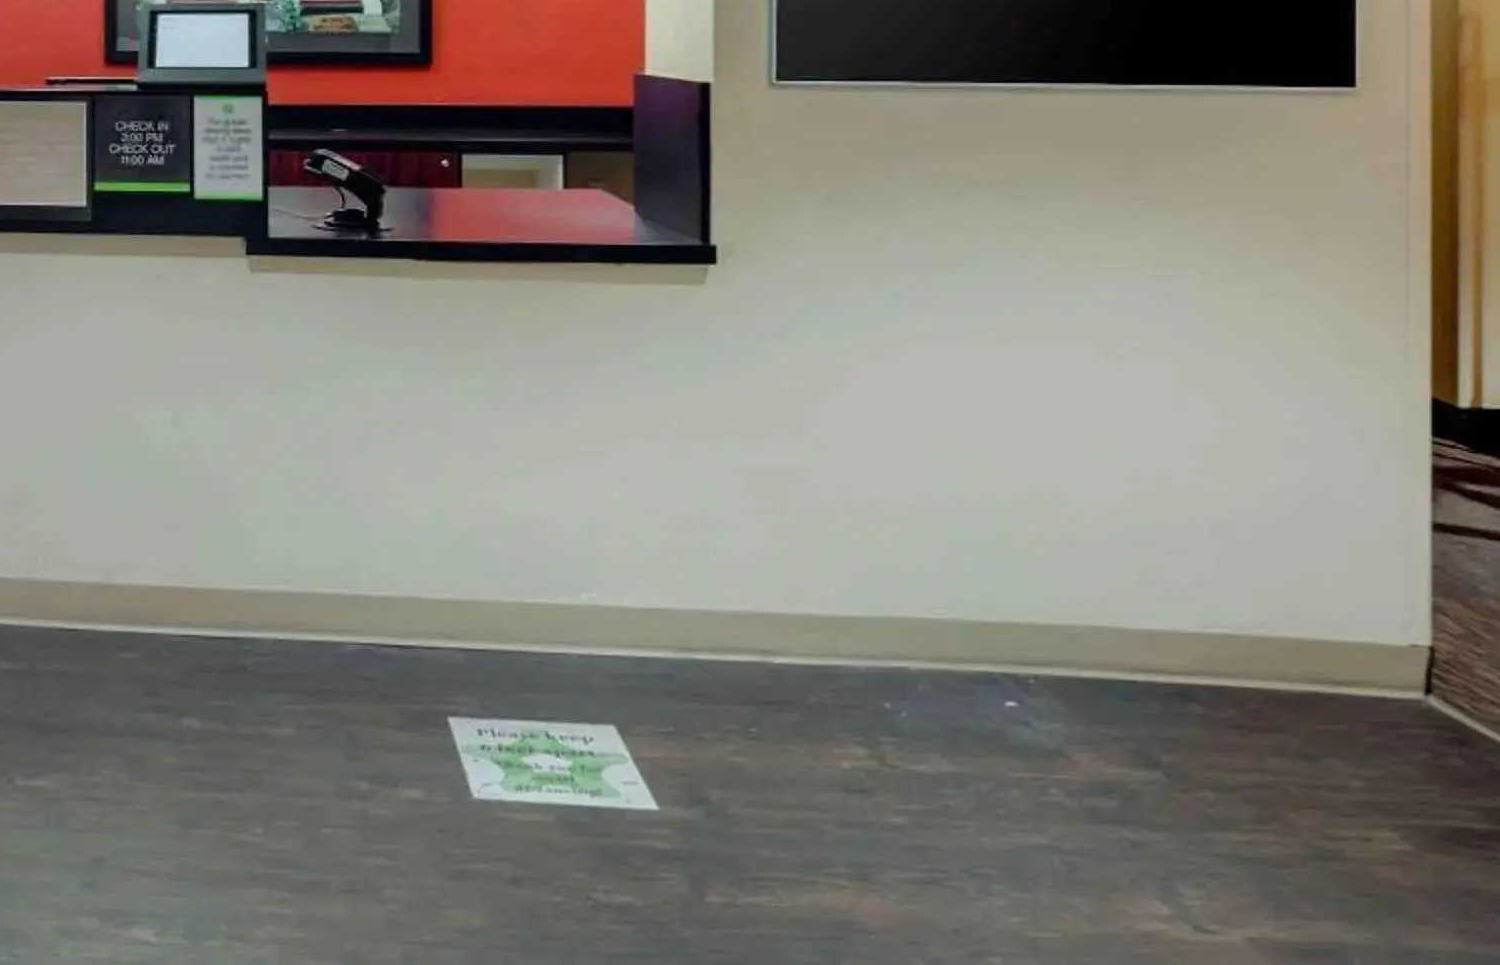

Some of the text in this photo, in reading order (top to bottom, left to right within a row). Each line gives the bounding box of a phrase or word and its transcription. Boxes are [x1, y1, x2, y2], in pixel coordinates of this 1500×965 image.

[115, 120, 169, 132] CHECK IN
[145, 132, 163, 143] PM
[108, 143, 176, 155] CHECK OUT
[146, 154, 165, 166] AM
